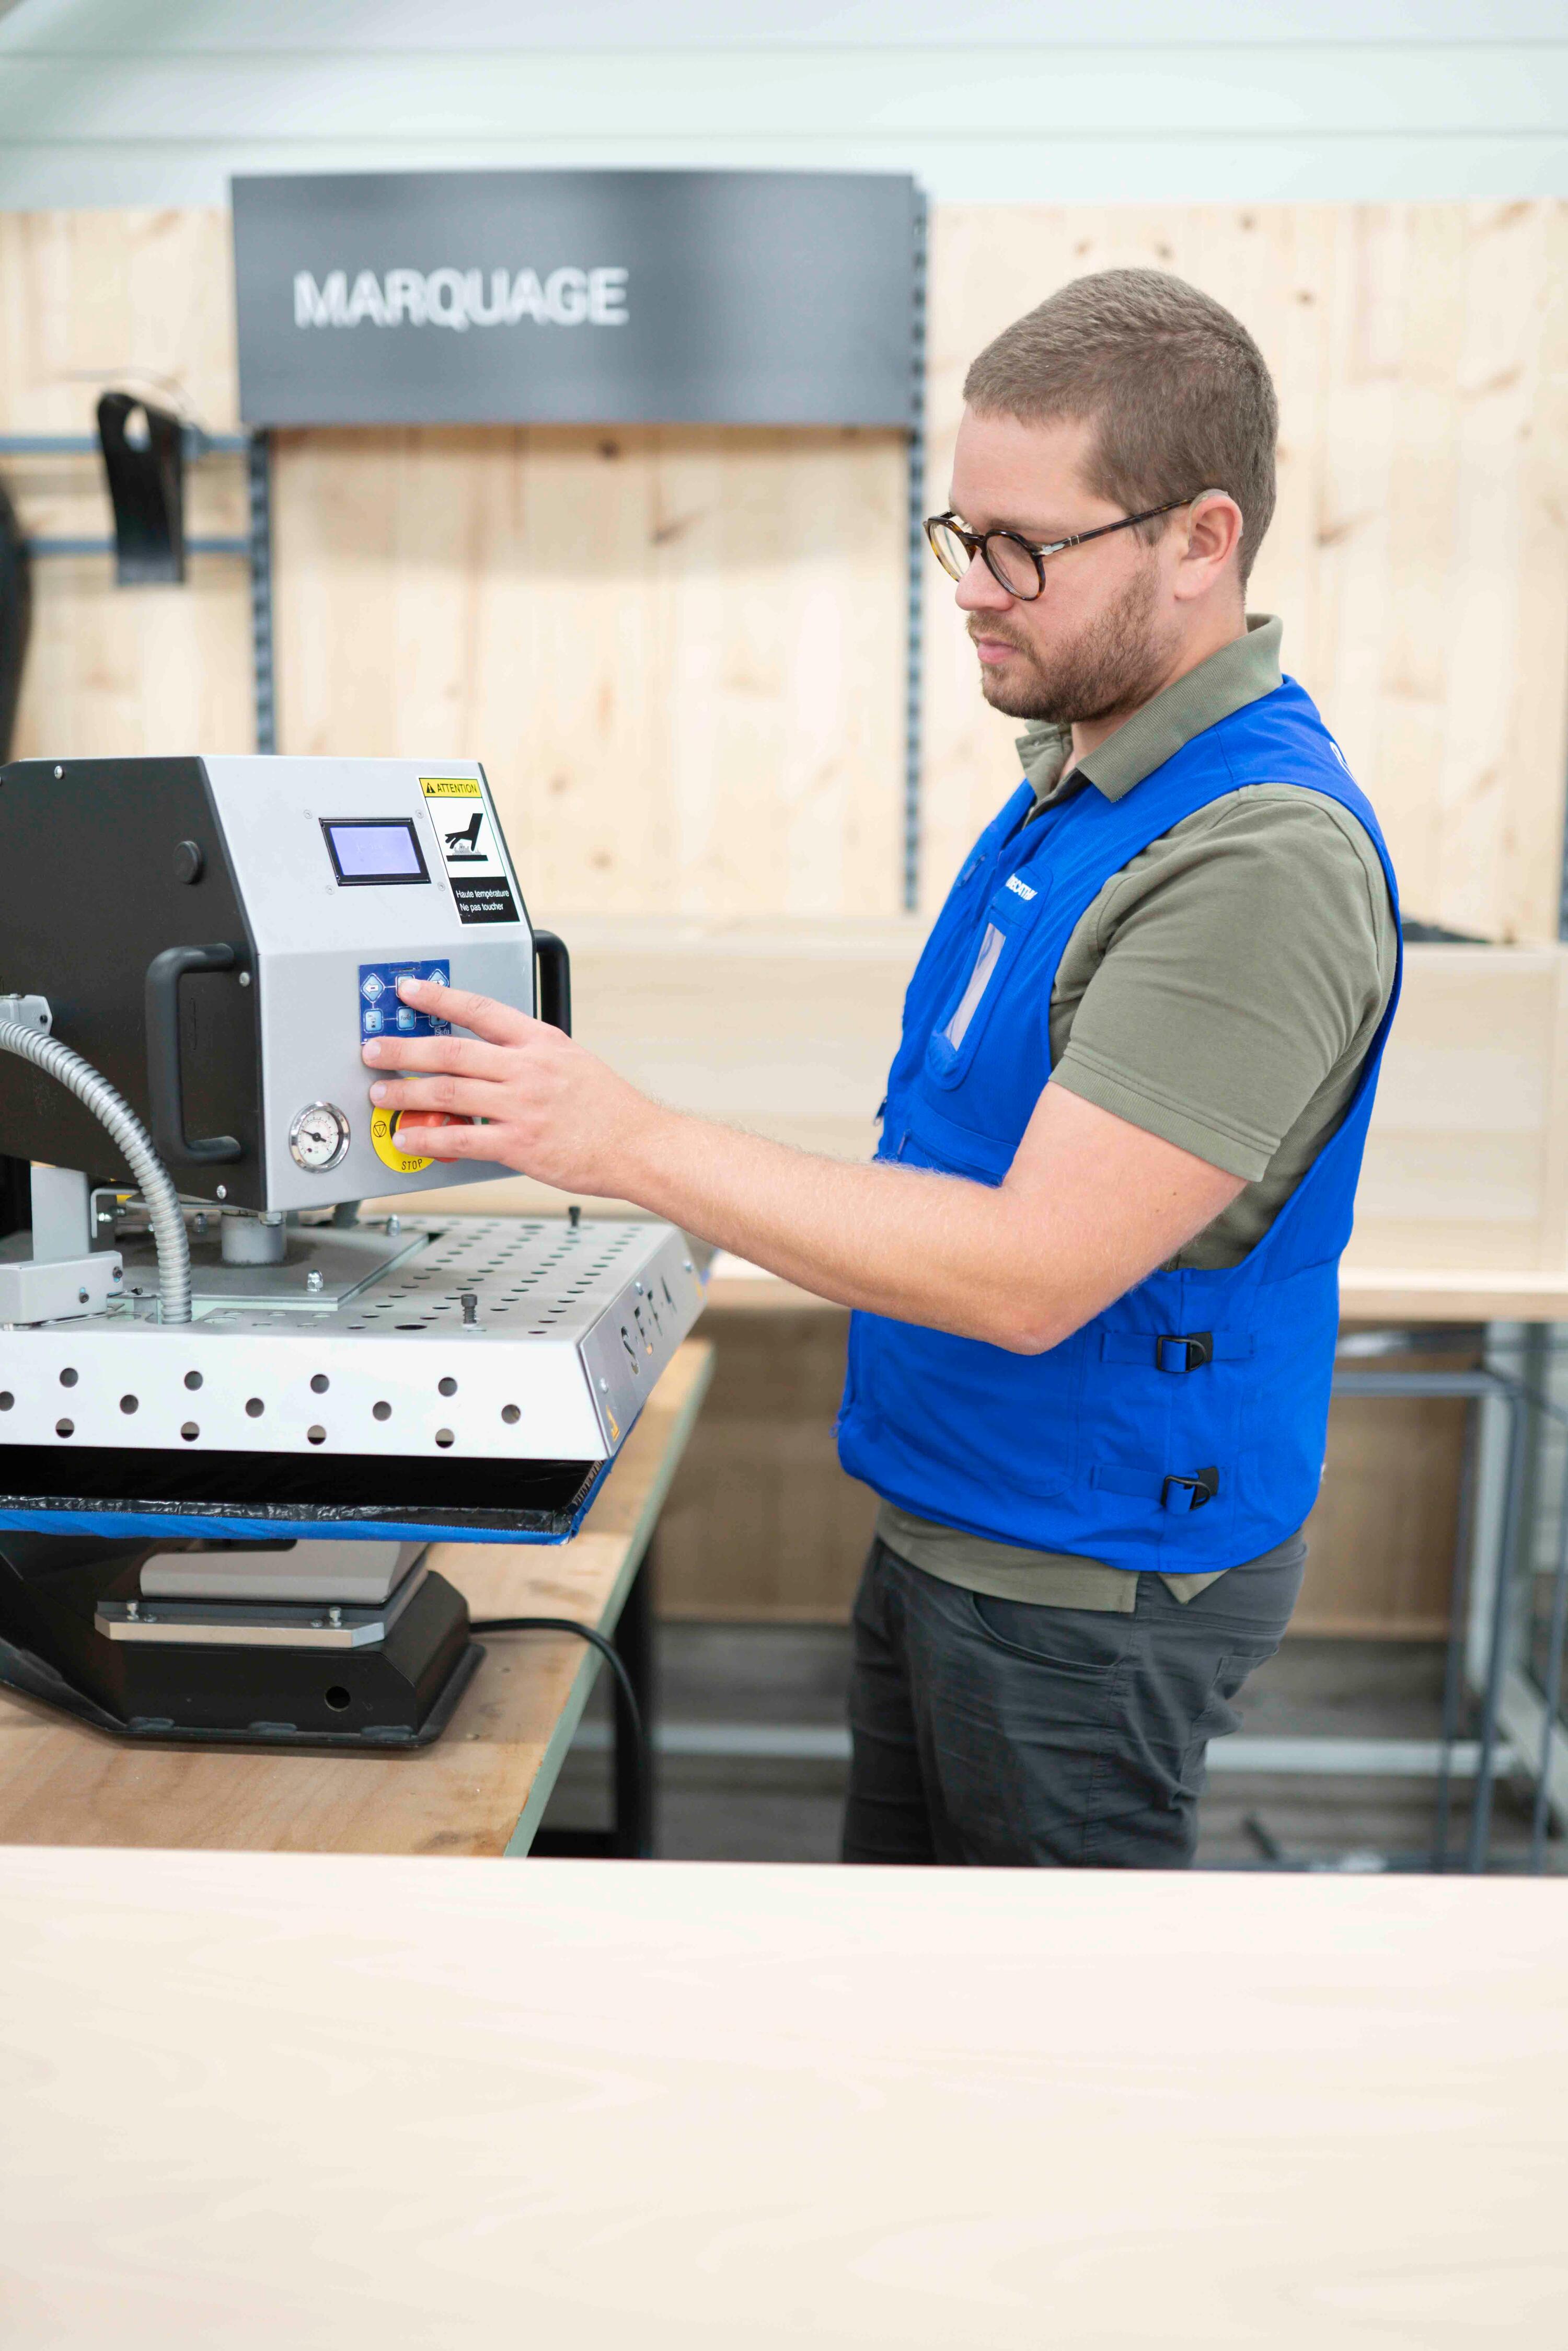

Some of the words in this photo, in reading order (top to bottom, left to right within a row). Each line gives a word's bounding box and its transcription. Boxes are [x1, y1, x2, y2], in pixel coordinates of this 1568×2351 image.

[294, 267, 630, 332] MARQUAGE
[437, 783, 478, 793] ATTENTION
[474, 890, 510, 899] température
[470, 904, 481, 913] pas
[401, 1159, 422, 1170] STOP
